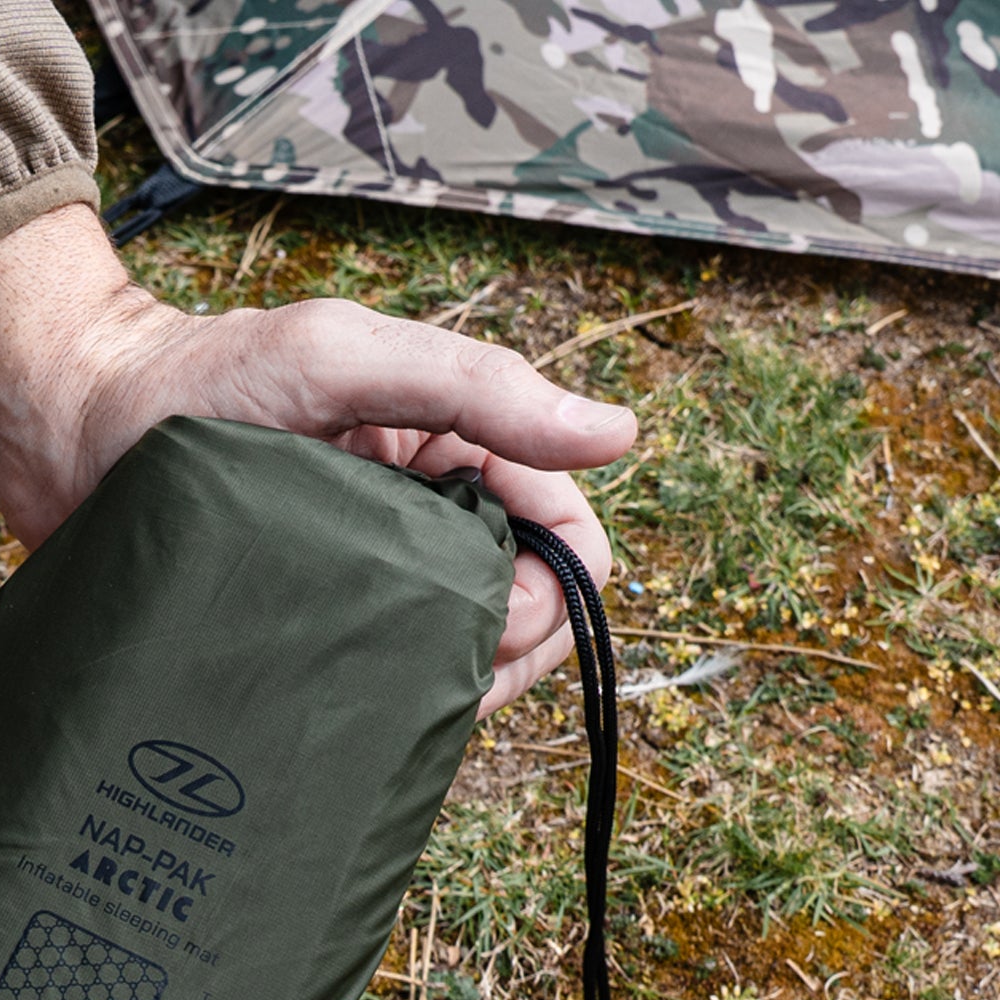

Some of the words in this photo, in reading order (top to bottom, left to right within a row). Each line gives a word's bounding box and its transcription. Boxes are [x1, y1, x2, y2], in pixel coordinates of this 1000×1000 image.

[79, 814, 216, 896] NAP-PAK
[96, 779, 236, 857] HIGHLANDER
[17, 855, 100, 907] Inflatable
[103, 900, 181, 949] sleeping
[183, 941, 220, 967] mat
[69, 850, 194, 922] ARCTIC
